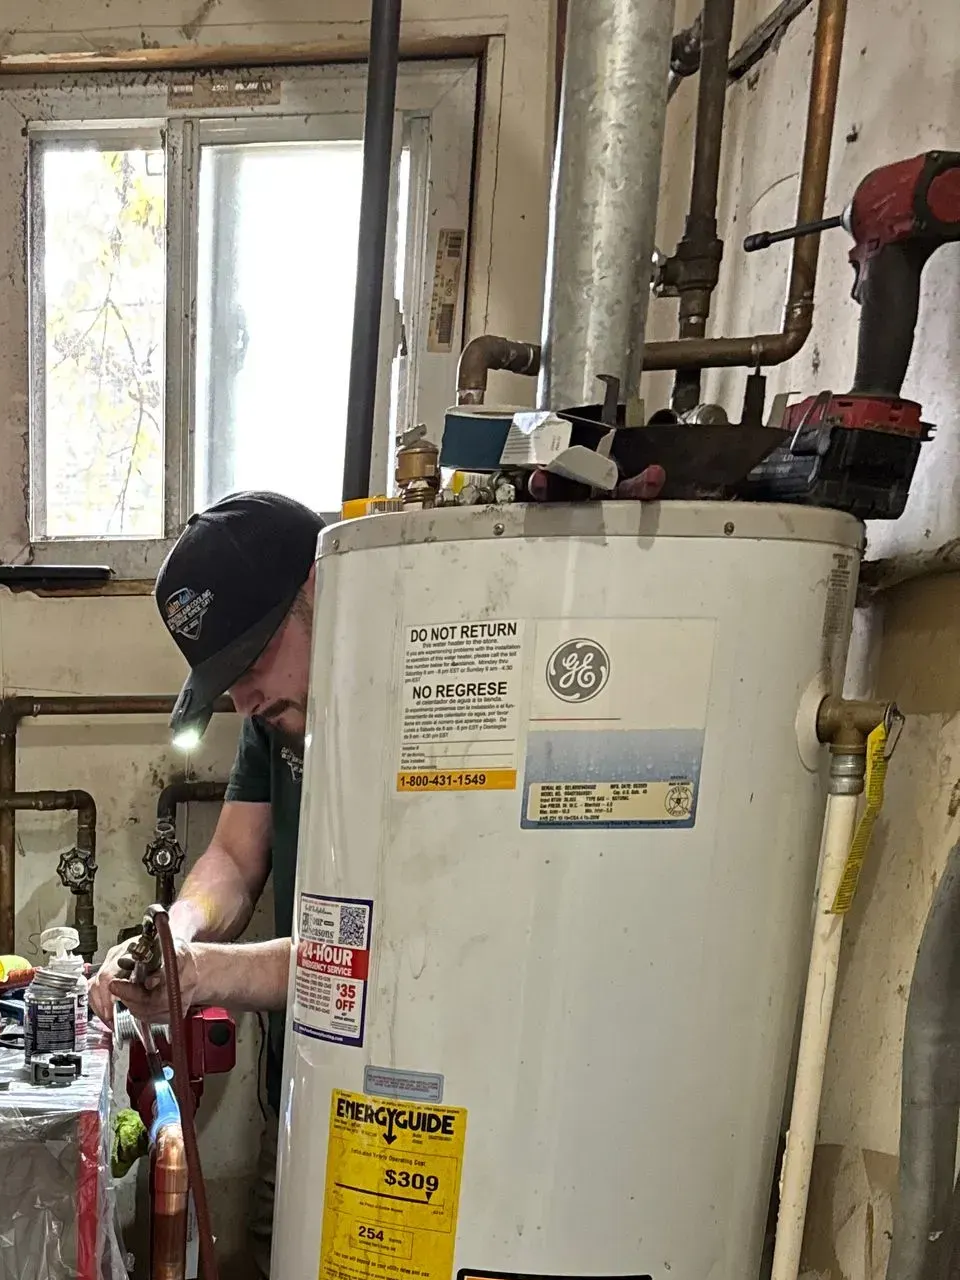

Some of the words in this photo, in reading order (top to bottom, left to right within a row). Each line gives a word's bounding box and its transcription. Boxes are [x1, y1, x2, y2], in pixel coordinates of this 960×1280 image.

[190, 589, 211, 608] COOLING
[411, 629, 427, 642] DO
[431, 626, 457, 640] NOT
[461, 622, 517, 638] RETURN
[413, 686, 431, 699] NO
[436, 682, 507, 698] REGRESE
[400, 774, 486, 786] 1-800-431-1549
[302, 941, 353, 966] 24-HOUR
[327, 965, 352, 976] SERVICE
[337, 984, 356, 999] $35
[336, 999, 355, 1012] OFF
[337, 1098, 455, 1135] ENERGYGUIDE
[384, 1169, 439, 1191] $309
[358, 1226, 384, 1241] 254
